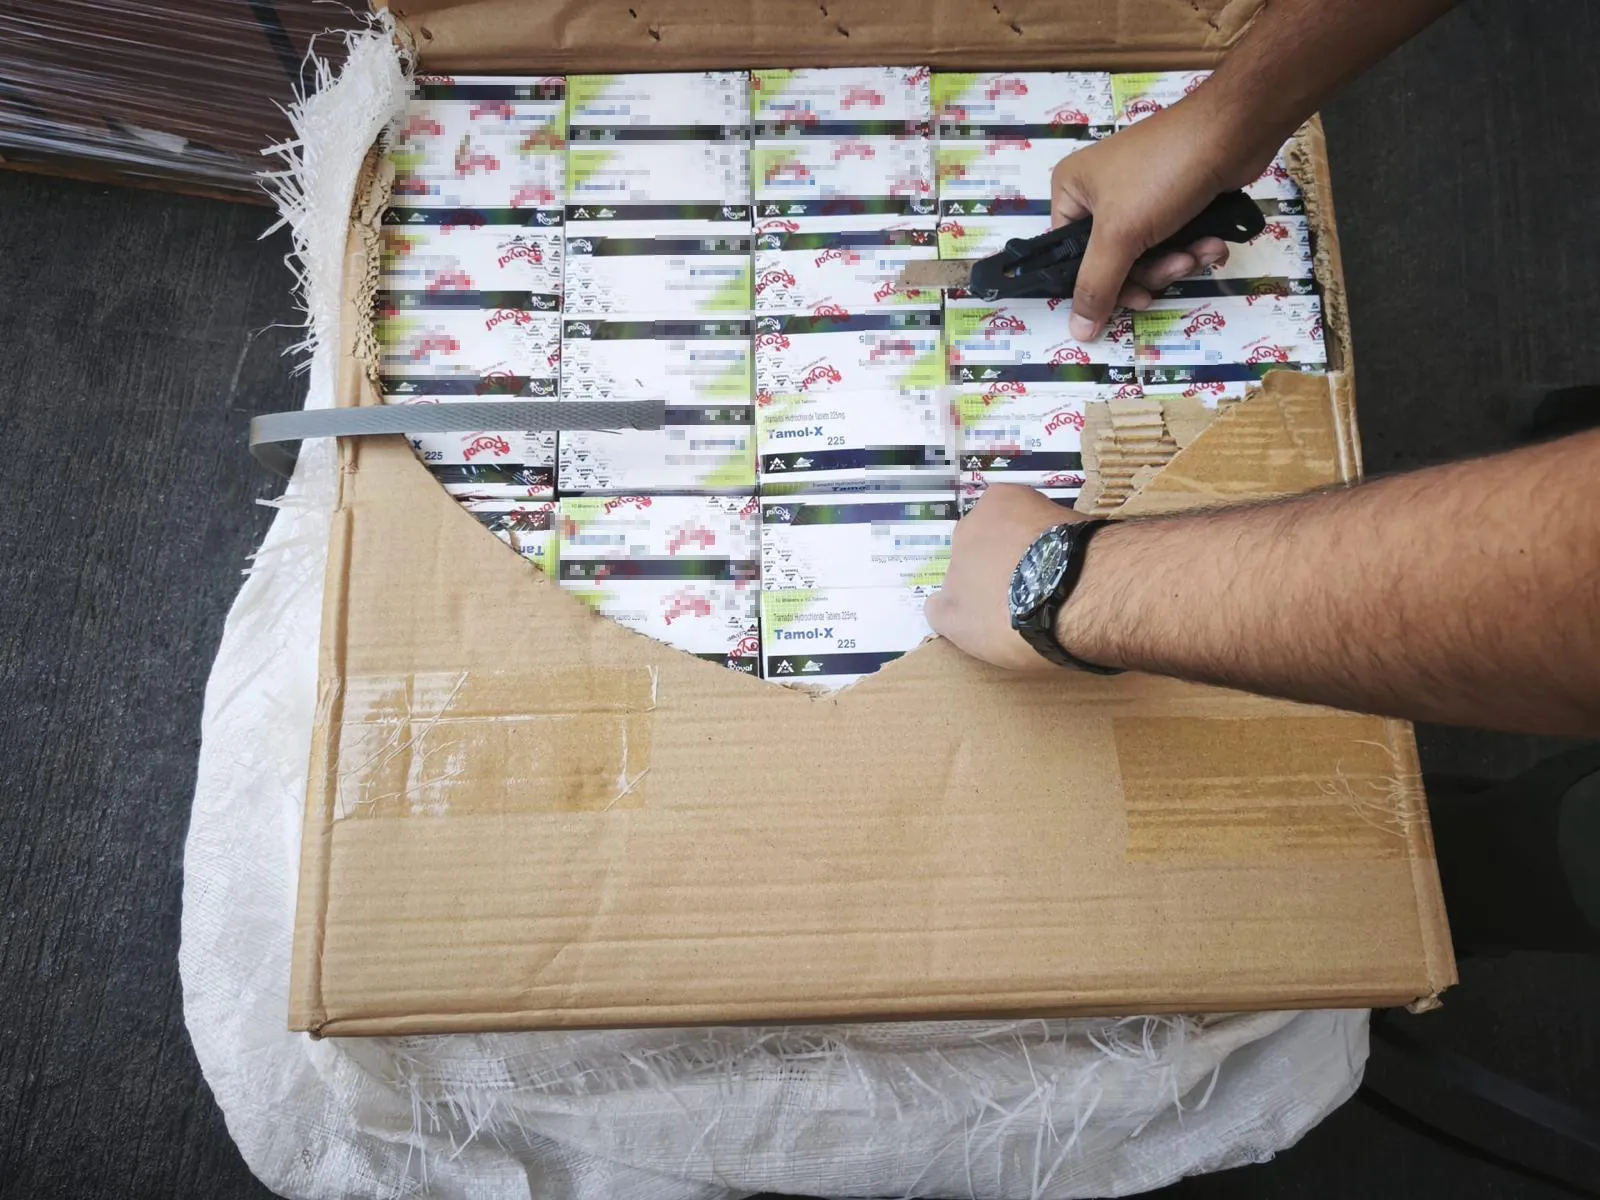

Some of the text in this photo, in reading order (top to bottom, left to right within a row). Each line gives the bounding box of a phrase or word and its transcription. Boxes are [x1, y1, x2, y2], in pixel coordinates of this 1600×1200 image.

[536, 213, 560, 225] Royal
[722, 207, 746, 220] Royal
[1289, 281, 1313, 294] Royal
[531, 296, 556, 309] Royal
[485, 307, 532, 331] Royal
[1183, 311, 1226, 337] Royal
[802, 364, 842, 390] Royal
[1108, 368, 1133, 381] Royal
[529, 381, 554, 395] Royal
[1045, 410, 1085, 435] Royal
[768, 426, 824, 440] Tamol-X
[827, 436, 846, 446] 225
[463, 435, 511, 461] Royal
[424, 451, 443, 460] 225
[774, 627, 834, 640] Tamol-X
[837, 639, 856, 648] 225
